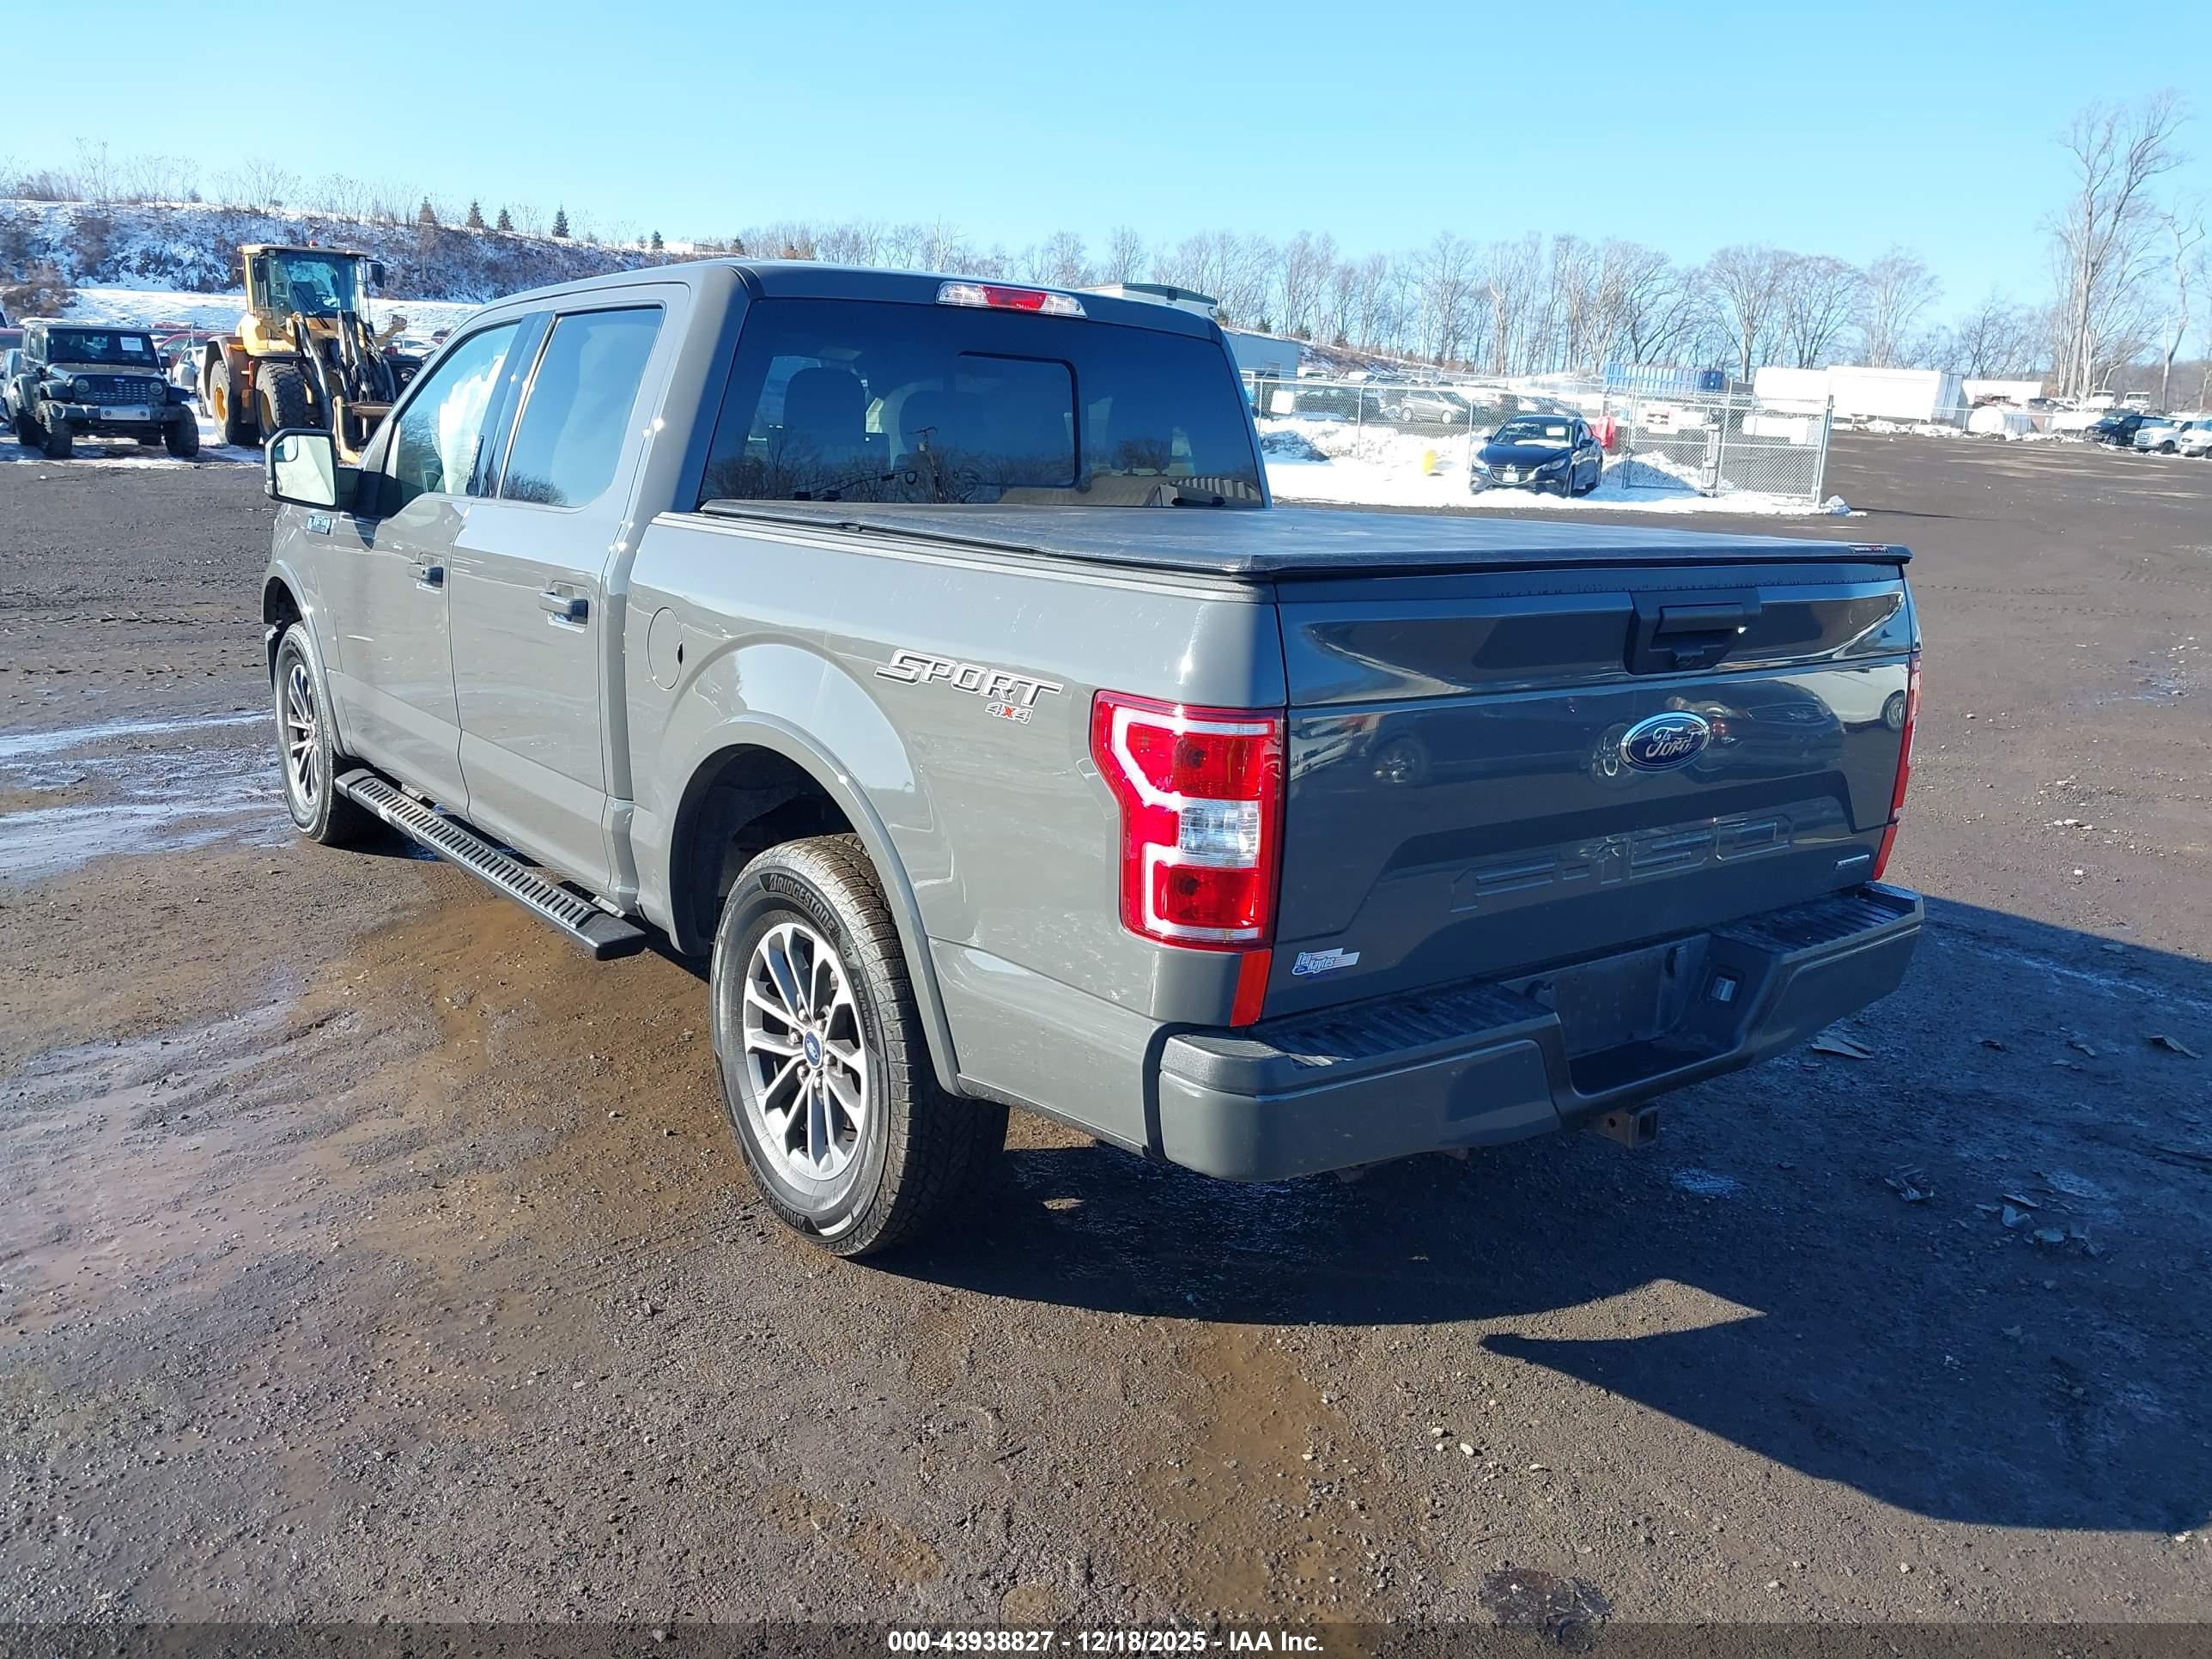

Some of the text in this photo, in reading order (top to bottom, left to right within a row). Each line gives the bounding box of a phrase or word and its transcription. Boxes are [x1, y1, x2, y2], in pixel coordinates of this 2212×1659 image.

[874, 648, 1064, 708] SPORT
[1645, 726, 1698, 757] Ford
[1450, 813, 1796, 913] F-150
[769, 874, 837, 935] BRIDGESTONE
